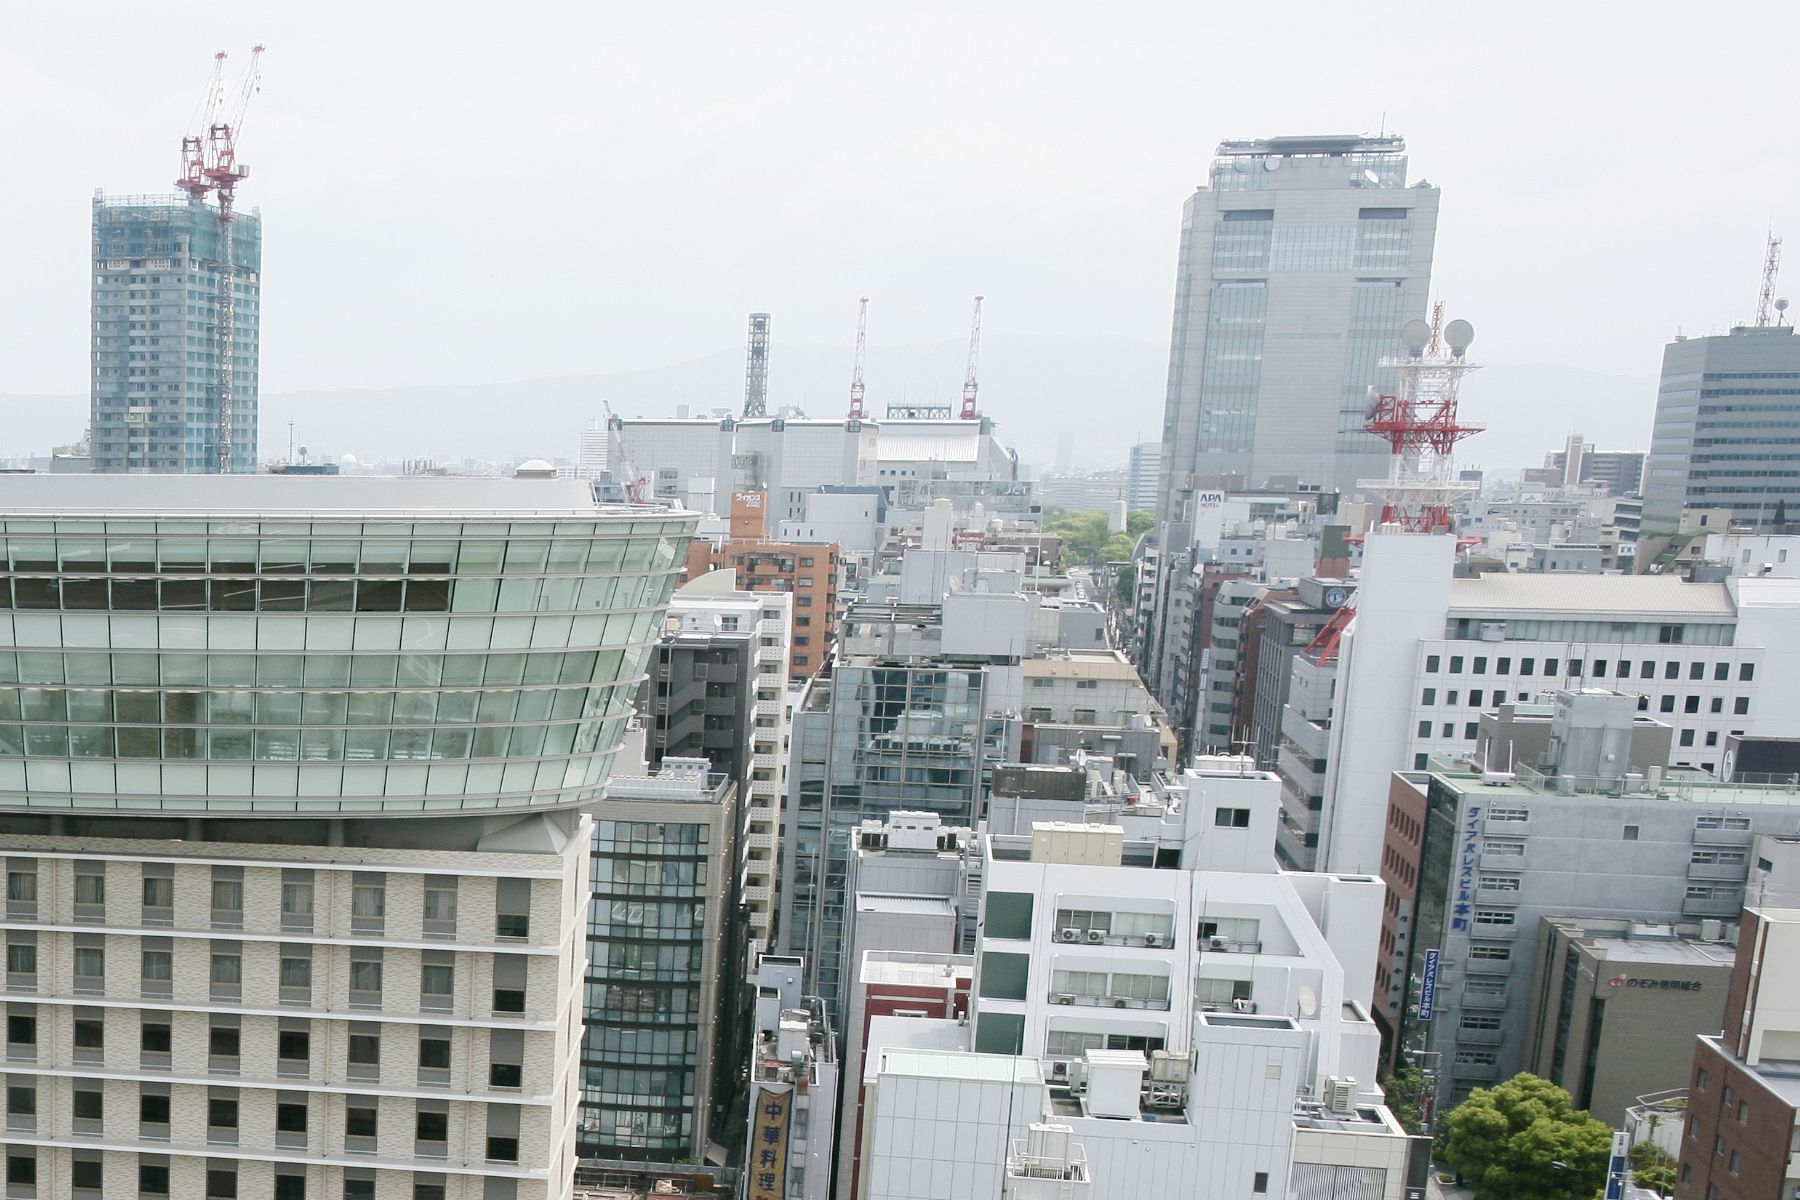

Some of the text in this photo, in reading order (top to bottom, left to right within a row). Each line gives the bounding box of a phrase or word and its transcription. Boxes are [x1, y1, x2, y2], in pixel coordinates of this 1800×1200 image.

[1200, 493, 1222, 502] APA
[758, 1101, 783, 1192] 中華料理
